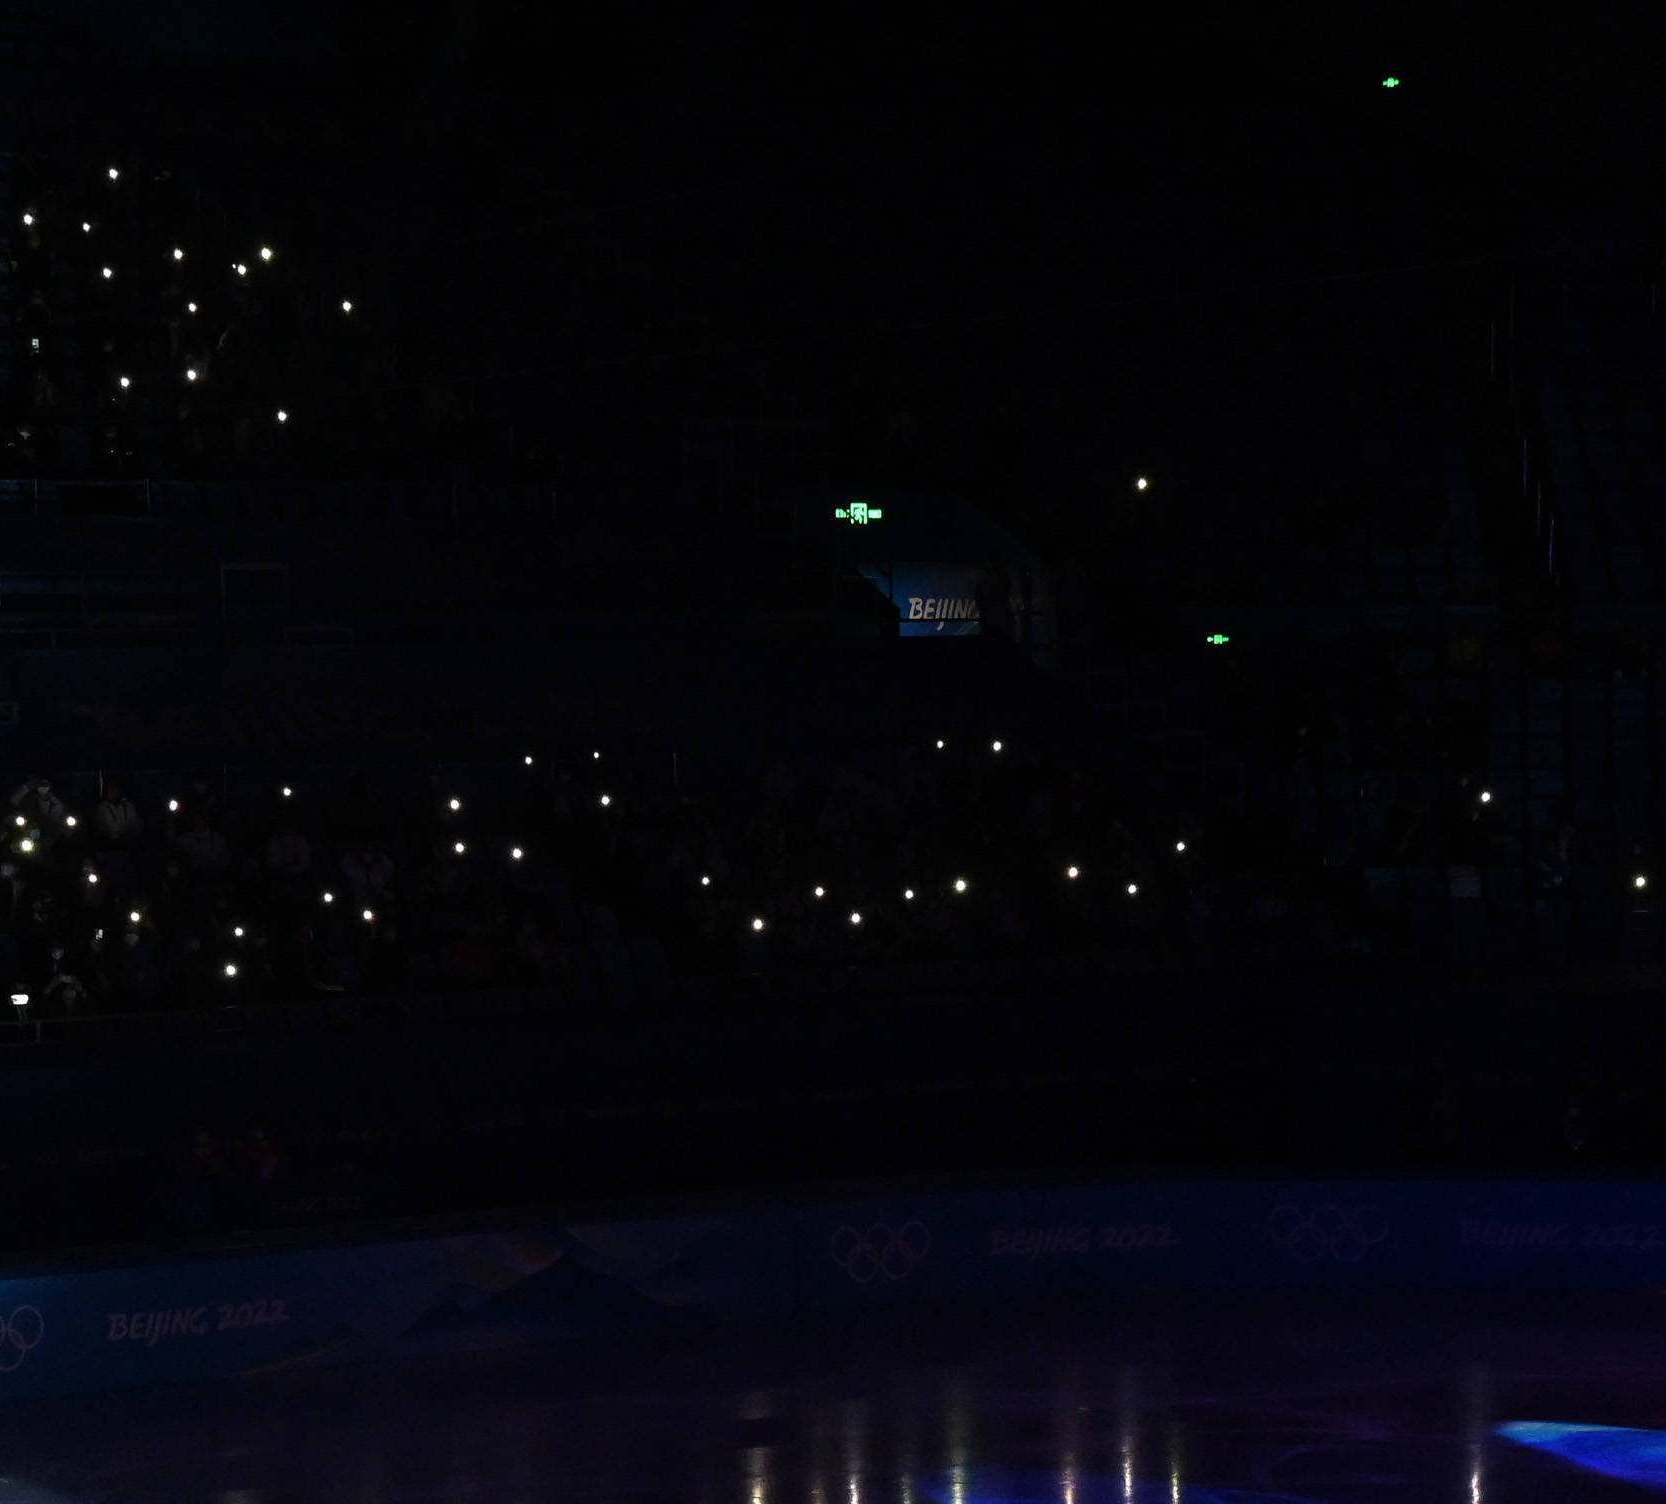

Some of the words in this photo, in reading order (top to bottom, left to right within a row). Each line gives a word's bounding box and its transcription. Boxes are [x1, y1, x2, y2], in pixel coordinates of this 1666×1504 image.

[989, 1225, 1091, 1261] BEIJING
[1099, 1222, 1181, 1250] 2022
[1459, 1217, 1569, 1255] BEIJING
[1581, 1222, 1666, 1250] 2022
[107, 1307, 209, 1348] BEIJING
[217, 1298, 291, 1331] 2022
